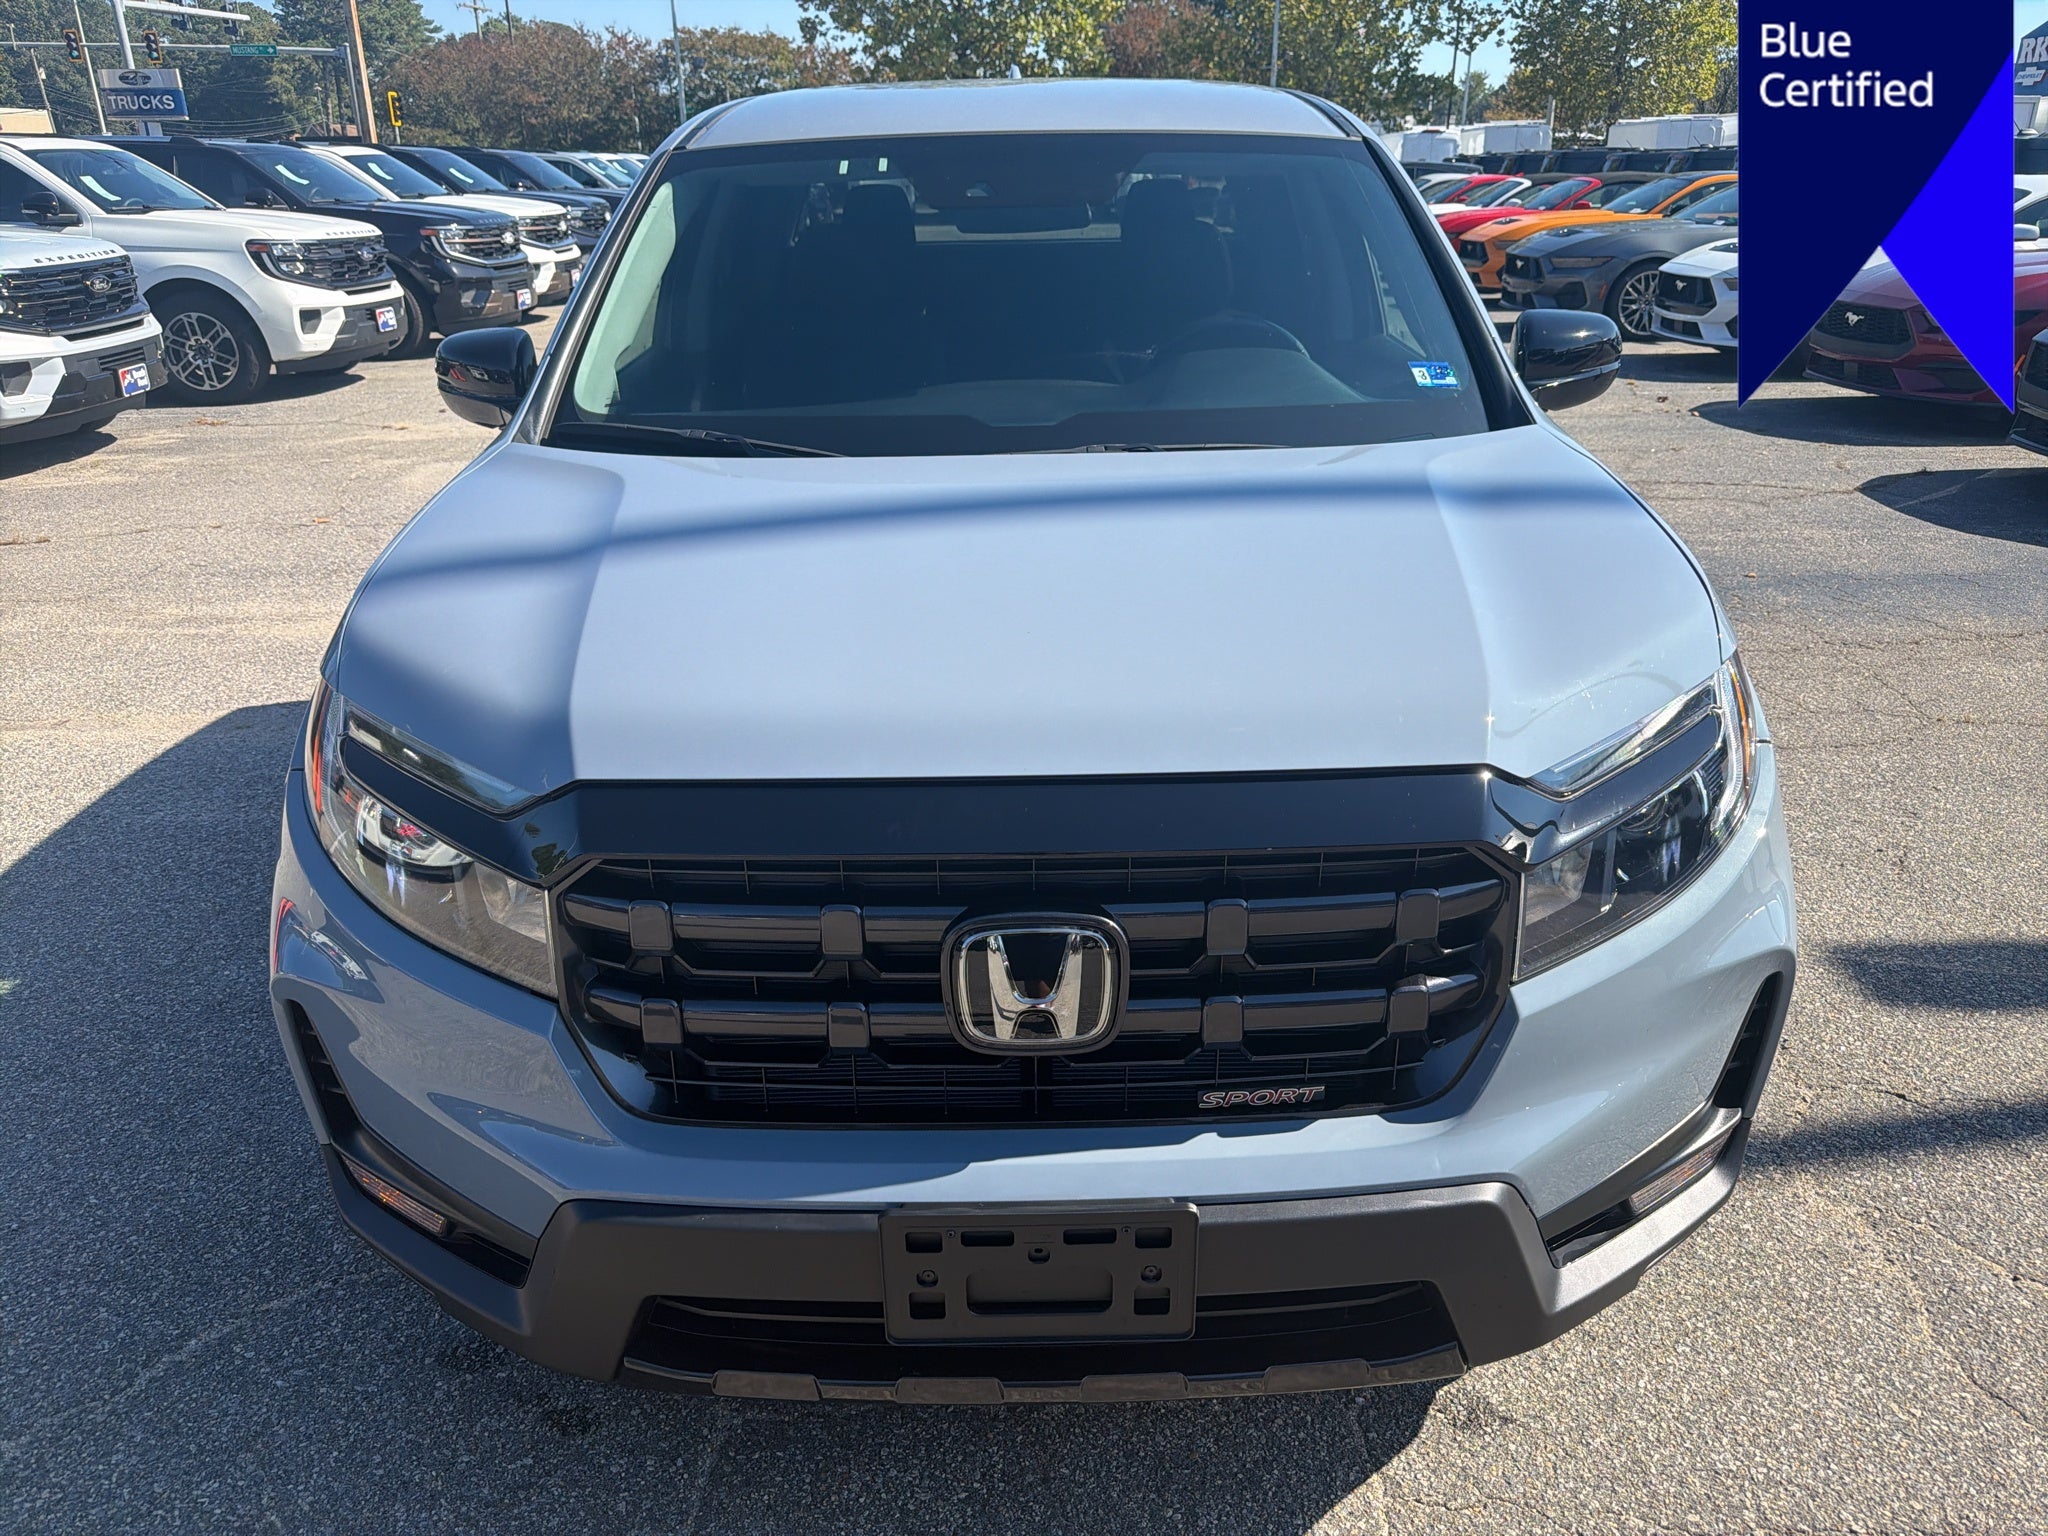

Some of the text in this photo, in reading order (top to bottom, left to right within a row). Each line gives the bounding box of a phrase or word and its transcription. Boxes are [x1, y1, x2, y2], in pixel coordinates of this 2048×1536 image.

[232, 46, 259, 55] MUSTANG
[107, 94, 175, 110] TRUCKS
[33, 249, 117, 264] EXPEDITION
[1199, 1086, 1325, 1109] SPORT
